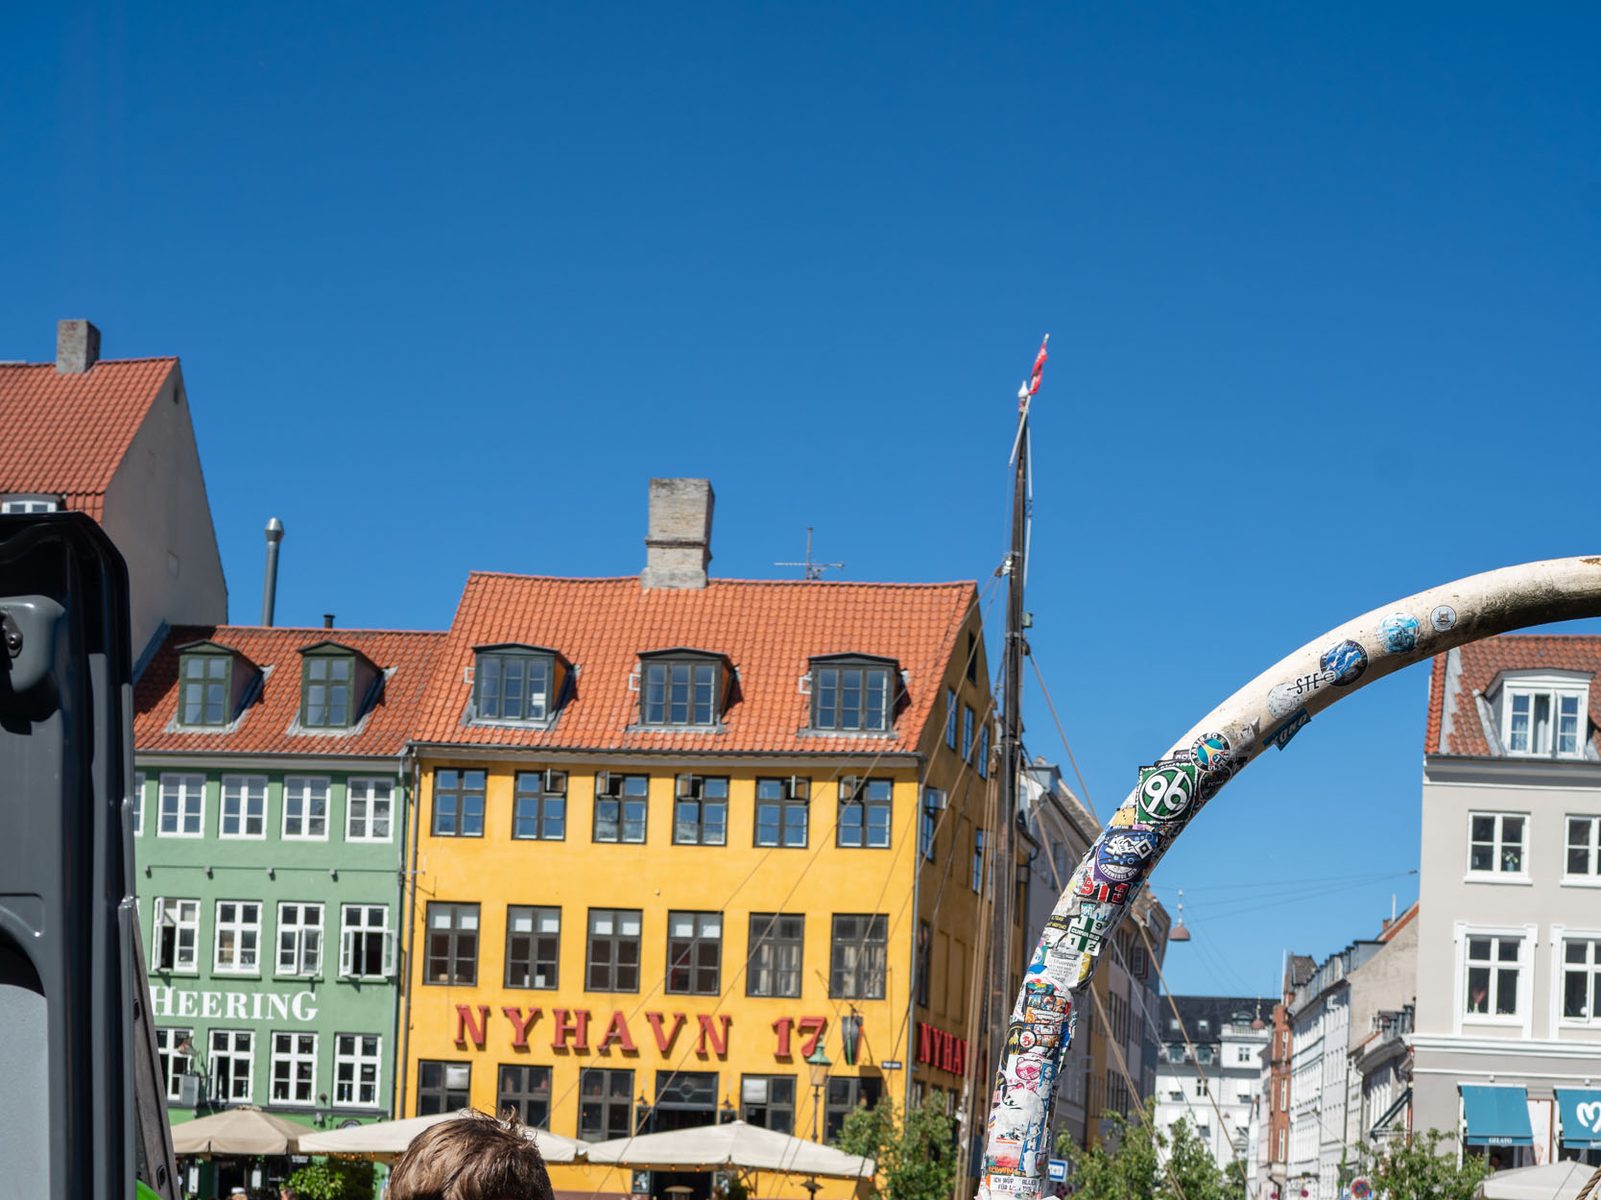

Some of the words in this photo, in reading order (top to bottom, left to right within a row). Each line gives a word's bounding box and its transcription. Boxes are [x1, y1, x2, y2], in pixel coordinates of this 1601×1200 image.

[1144, 771, 1188, 814] 96
[149, 985, 319, 1022] HEERING
[453, 1004, 733, 1059] NYHAVN
[770, 1016, 827, 1058] 17
[919, 1022, 967, 1076] NYHA
